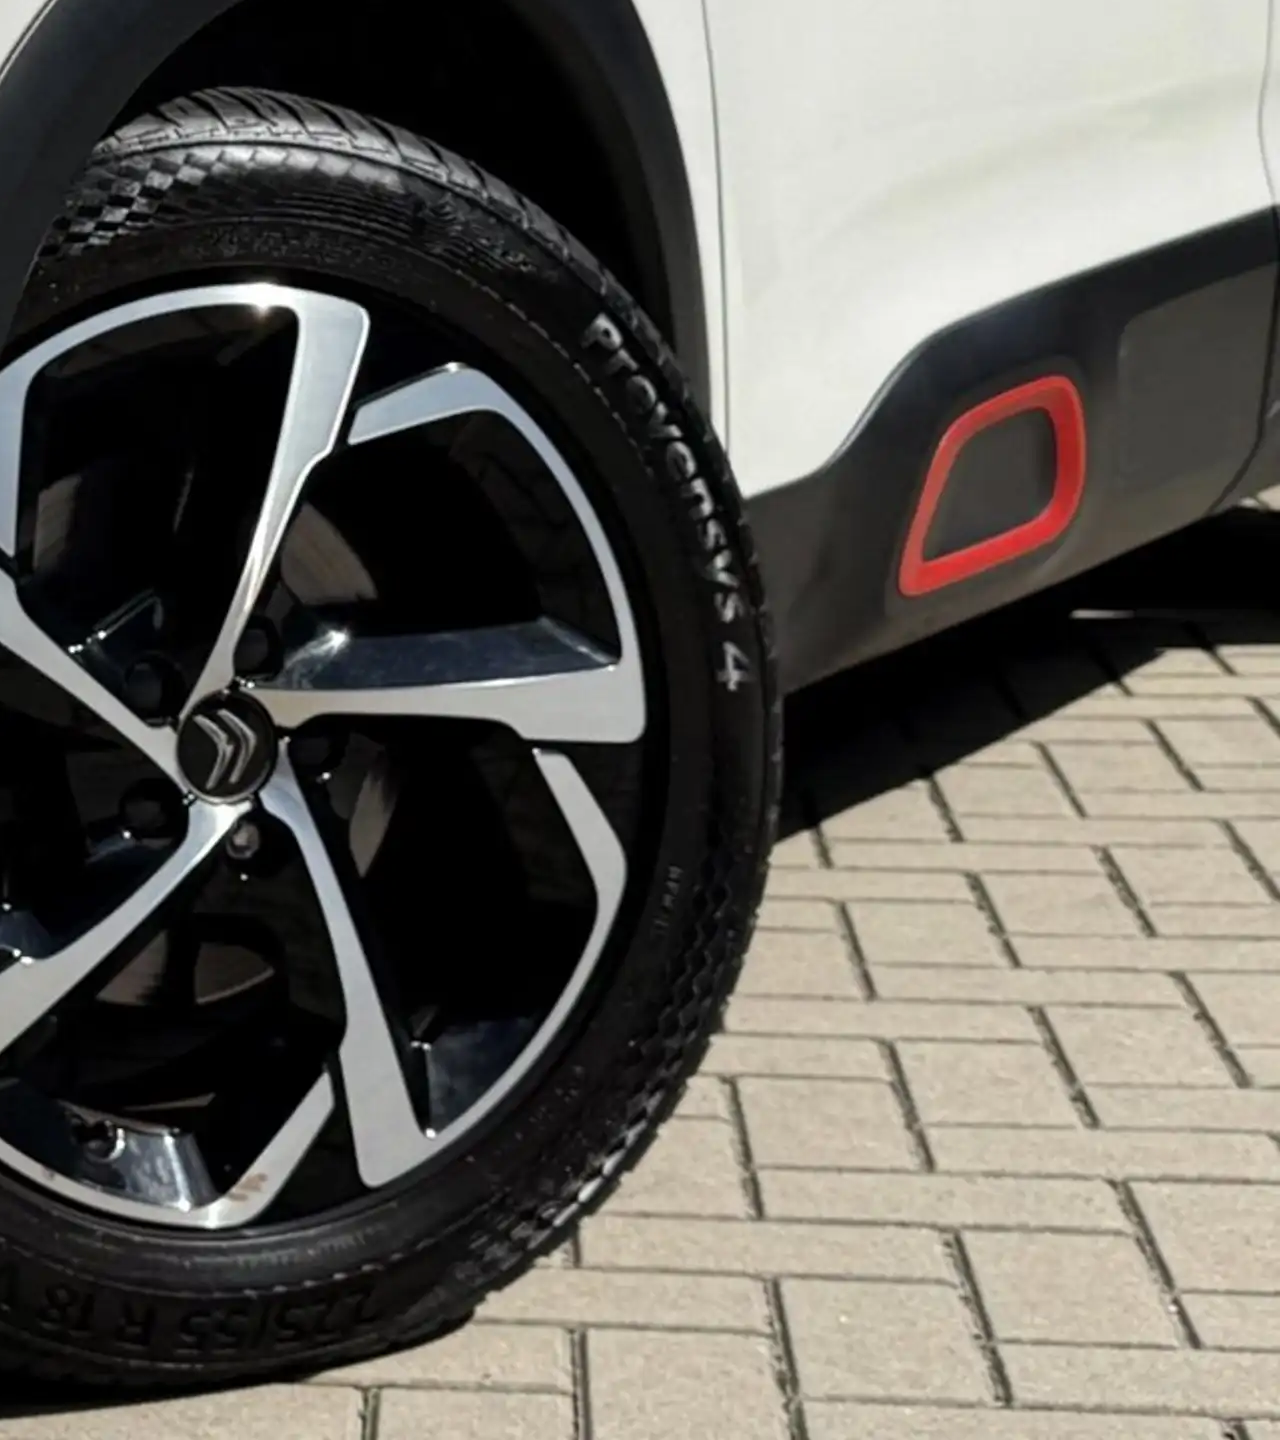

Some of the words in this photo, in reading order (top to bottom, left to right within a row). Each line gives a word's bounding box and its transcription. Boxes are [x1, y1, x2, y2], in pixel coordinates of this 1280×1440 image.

[714, 641, 752, 694] 4
[36, 1282, 95, 1336] 18
[116, 1302, 157, 1350] R
[172, 1285, 379, 1357] 225/55
